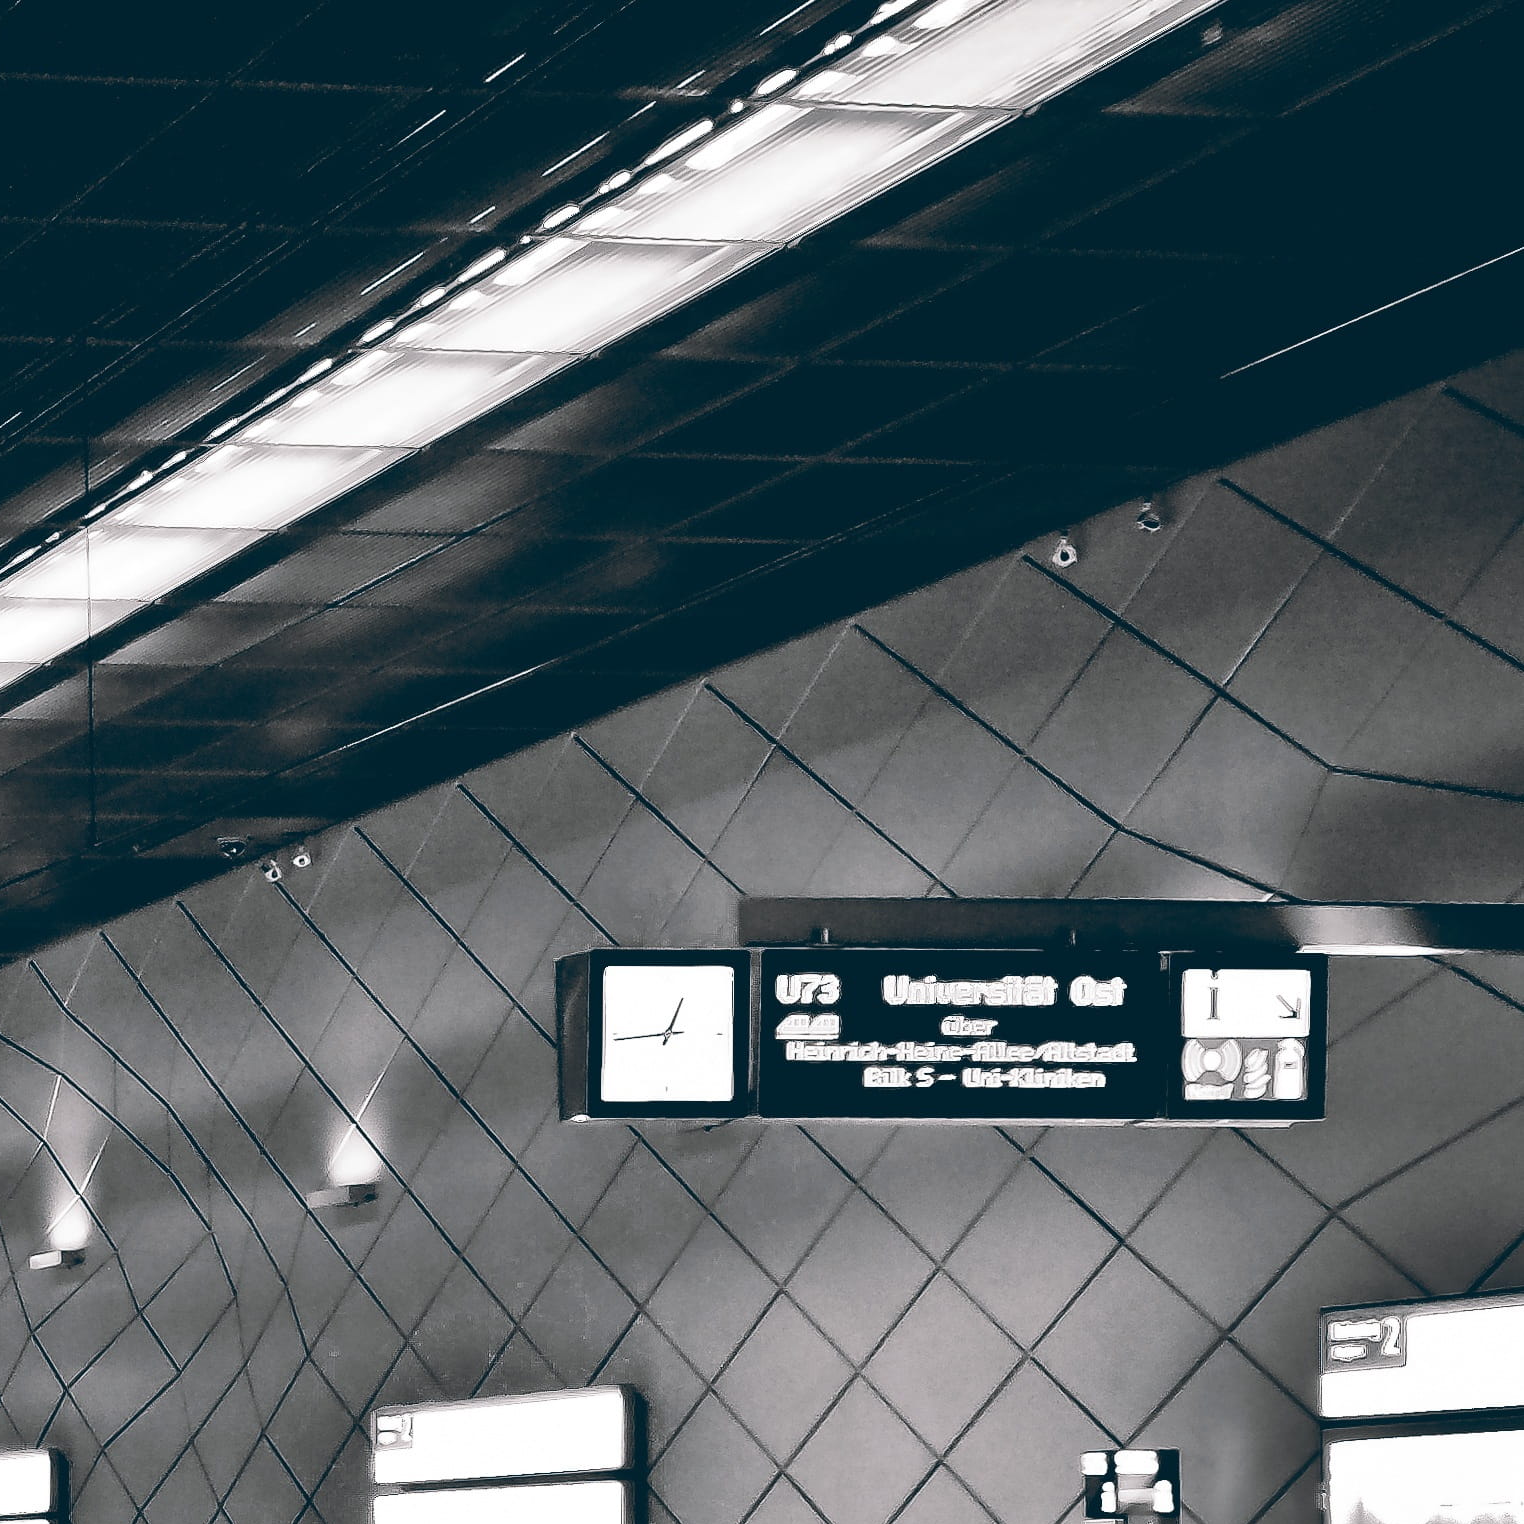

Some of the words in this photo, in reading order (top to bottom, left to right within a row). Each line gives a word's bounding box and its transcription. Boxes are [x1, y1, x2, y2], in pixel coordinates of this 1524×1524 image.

[775, 974, 841, 1004] U73
[883, 975, 1058, 1006] Universität
[1069, 976, 1127, 1006] Ost
